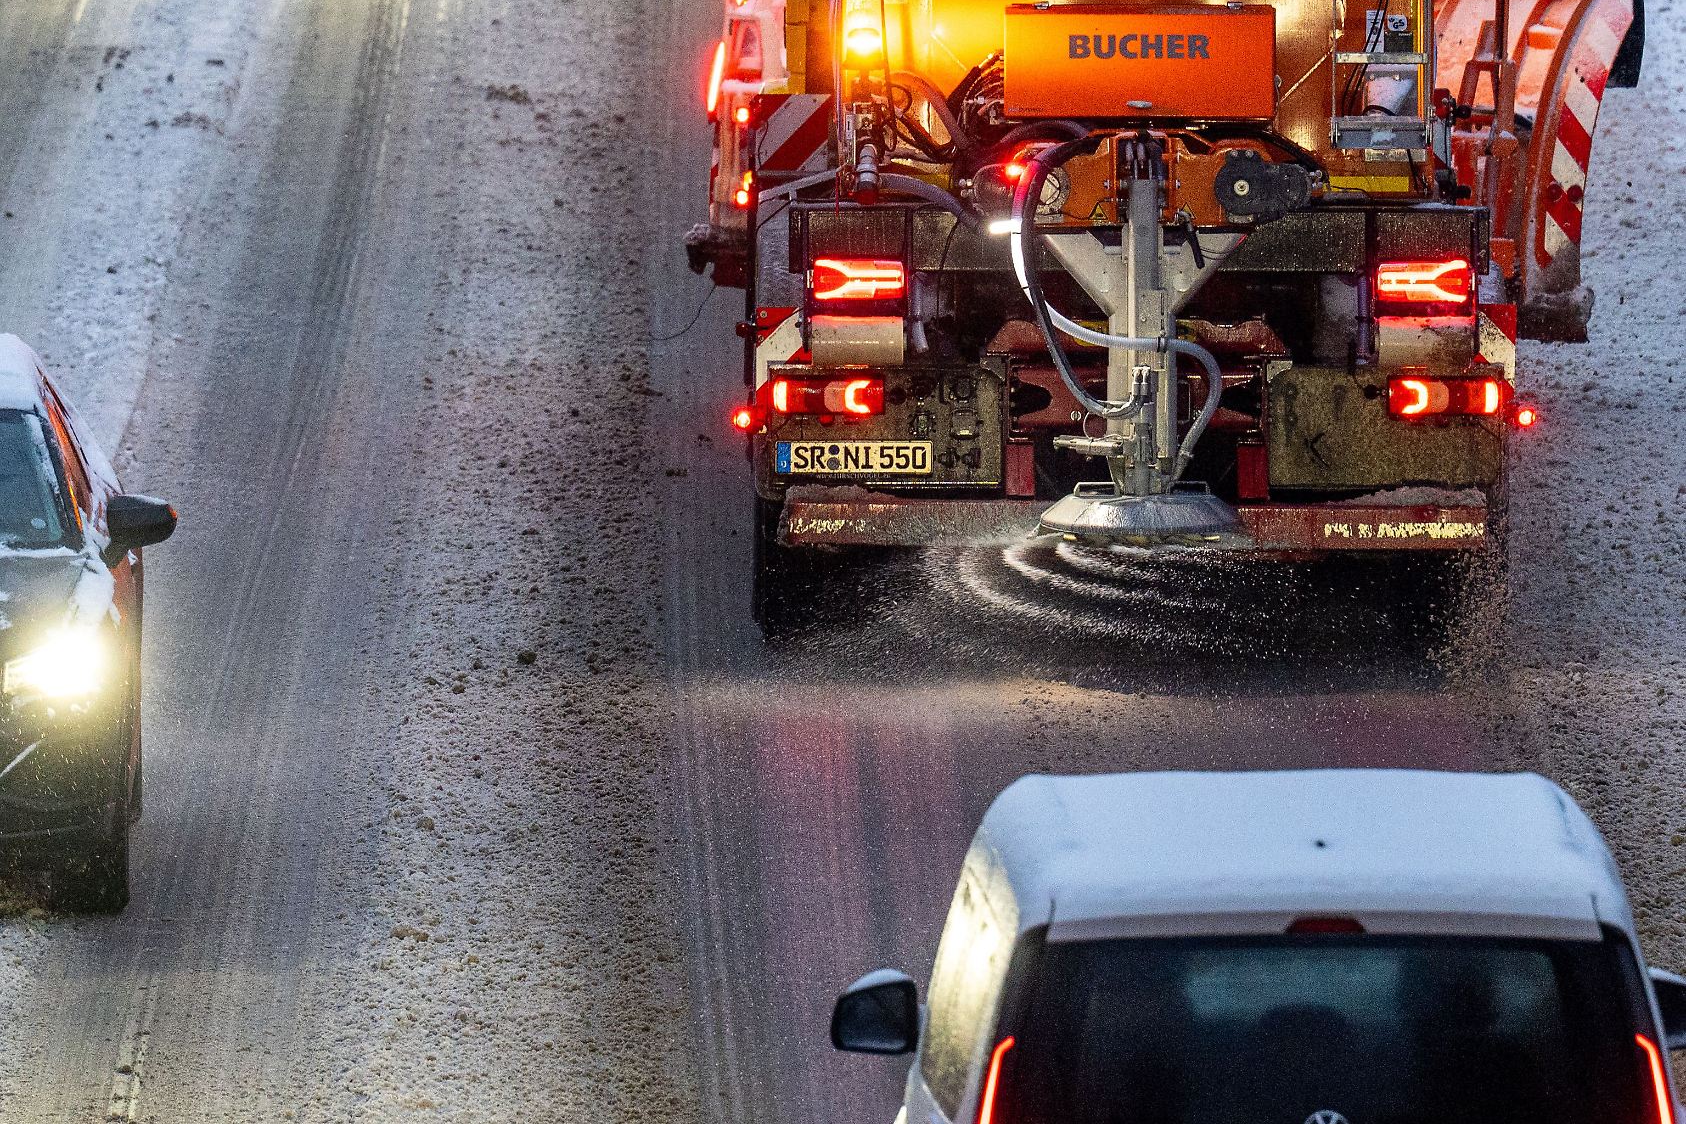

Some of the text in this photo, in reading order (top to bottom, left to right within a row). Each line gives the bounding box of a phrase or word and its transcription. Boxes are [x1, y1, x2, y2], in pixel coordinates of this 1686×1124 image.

[1069, 34, 1211, 59] BUCHER
[793, 446, 826, 470] SR
[843, 446, 874, 470] NI
[879, 446, 927, 470] 550
